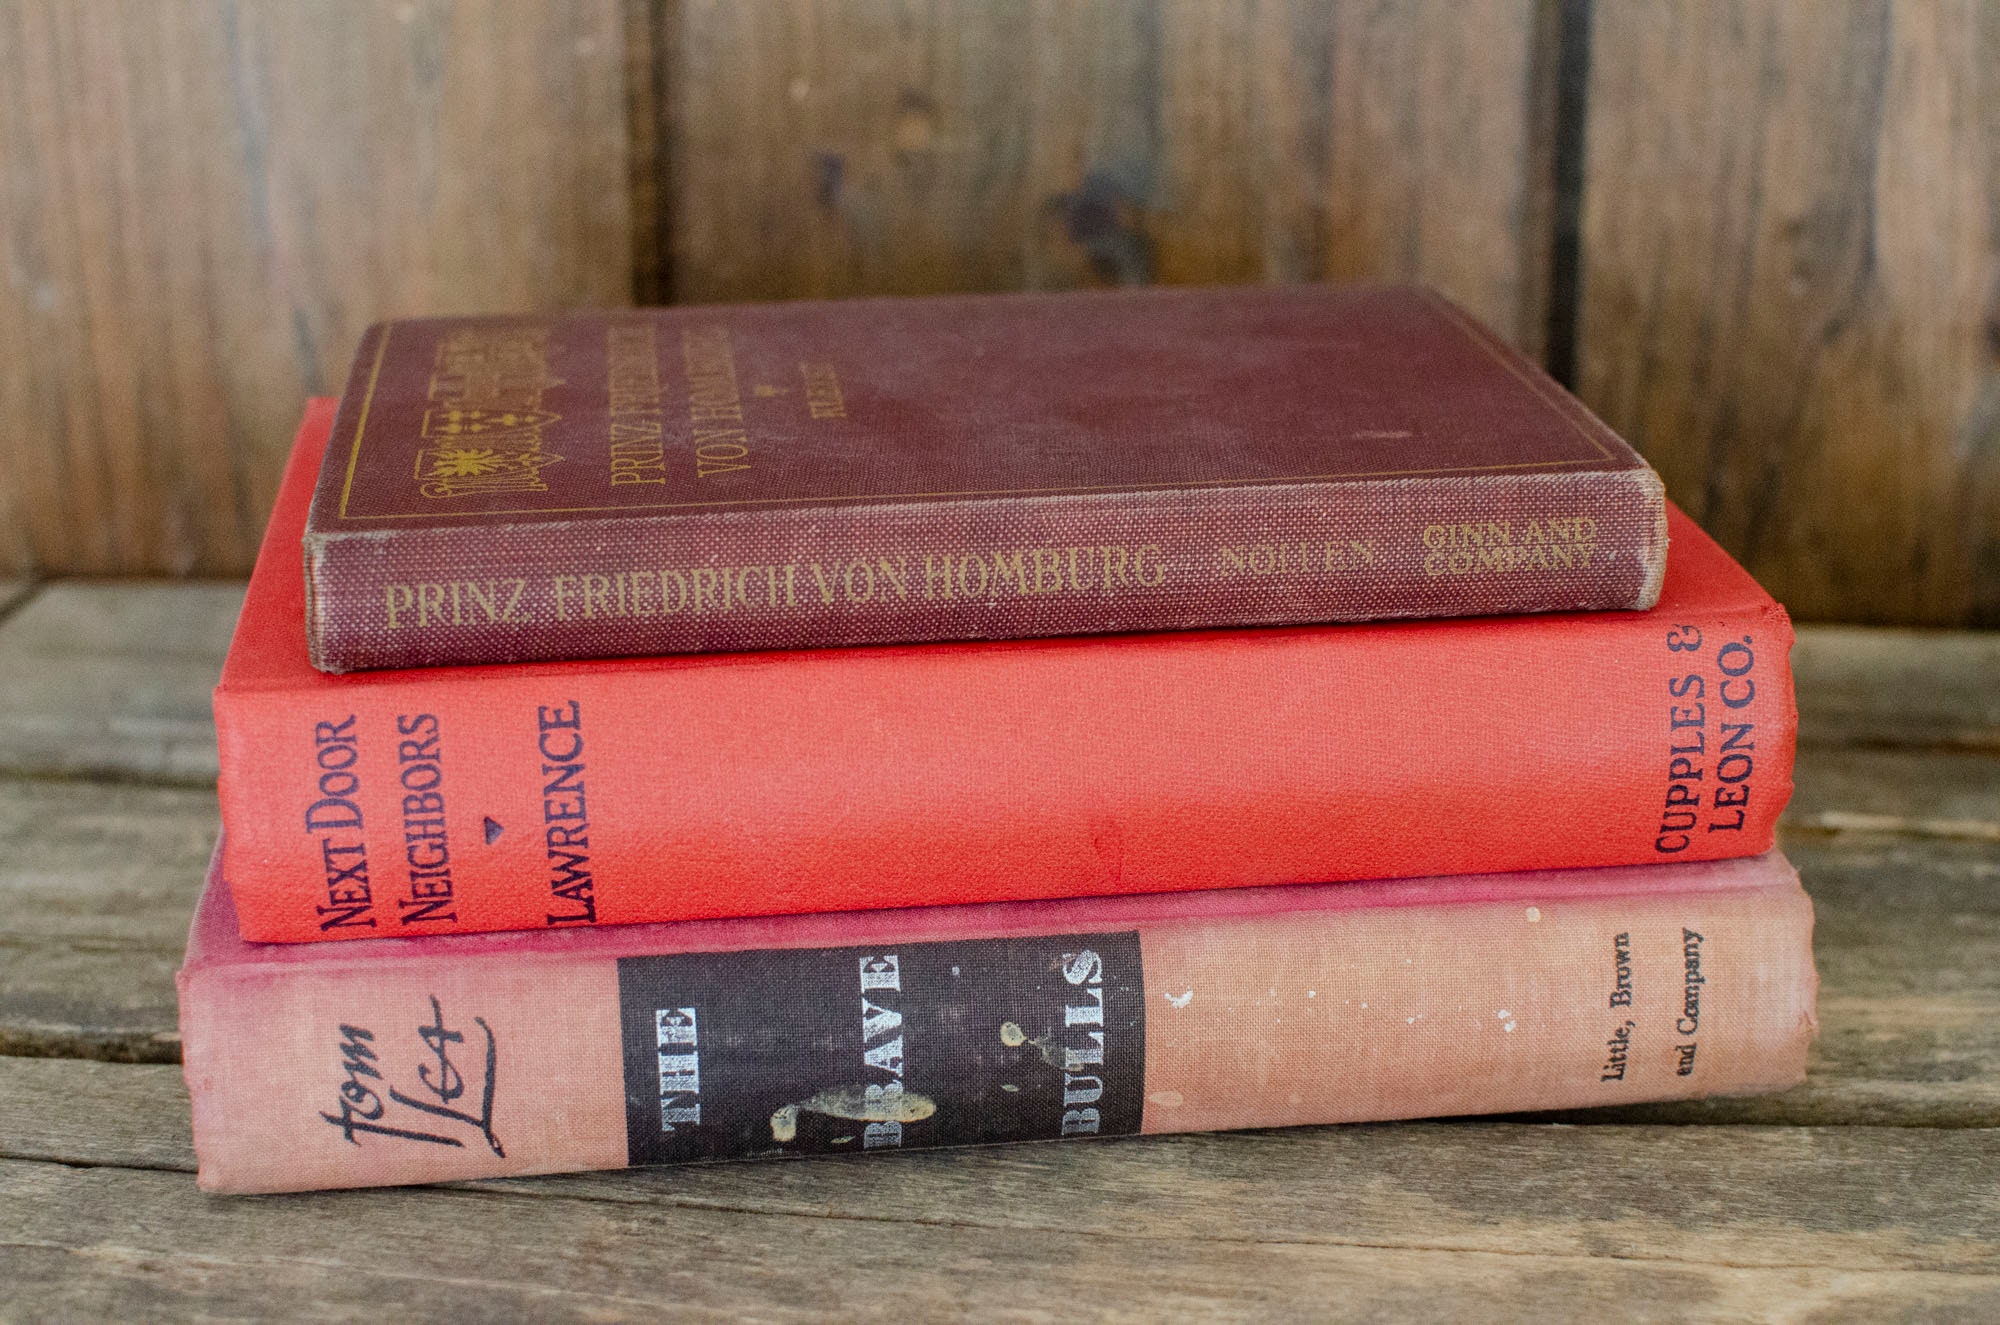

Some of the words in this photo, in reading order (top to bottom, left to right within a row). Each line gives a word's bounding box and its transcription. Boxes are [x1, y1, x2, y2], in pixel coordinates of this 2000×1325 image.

[611, 423, 665, 486] PRINZ
[692, 428, 751, 477] VON
[1424, 521, 1512, 549] GINN
[1525, 517, 1596, 545] AND
[1424, 543, 1596, 576] COMPANY
[386, 577, 530, 629] PRINZ
[555, 564, 797, 620] FRIEDRICH
[813, 554, 908, 603] VON
[925, 545, 1164, 600] HOMBURG
[1666, 624, 1702, 652] &
[1717, 635, 1755, 709] CO.
[305, 714, 364, 834] DOOR
[1655, 674, 1706, 853] CUPPLES
[1709, 722, 1755, 833] LEON
[398, 713, 458, 925] NEIGHBORS
[538, 700, 597, 926] LAWRENCE
[317, 838, 377, 931] NEXT
[1610, 932, 1632, 1008] Brown
[1676, 927, 1705, 1036] Company
[655, 1007, 700, 1132] THE
[860, 955, 904, 1149] BRAVE
[1062, 949, 1104, 1136] BULLS
[1601, 1020, 1635, 1083] Little,
